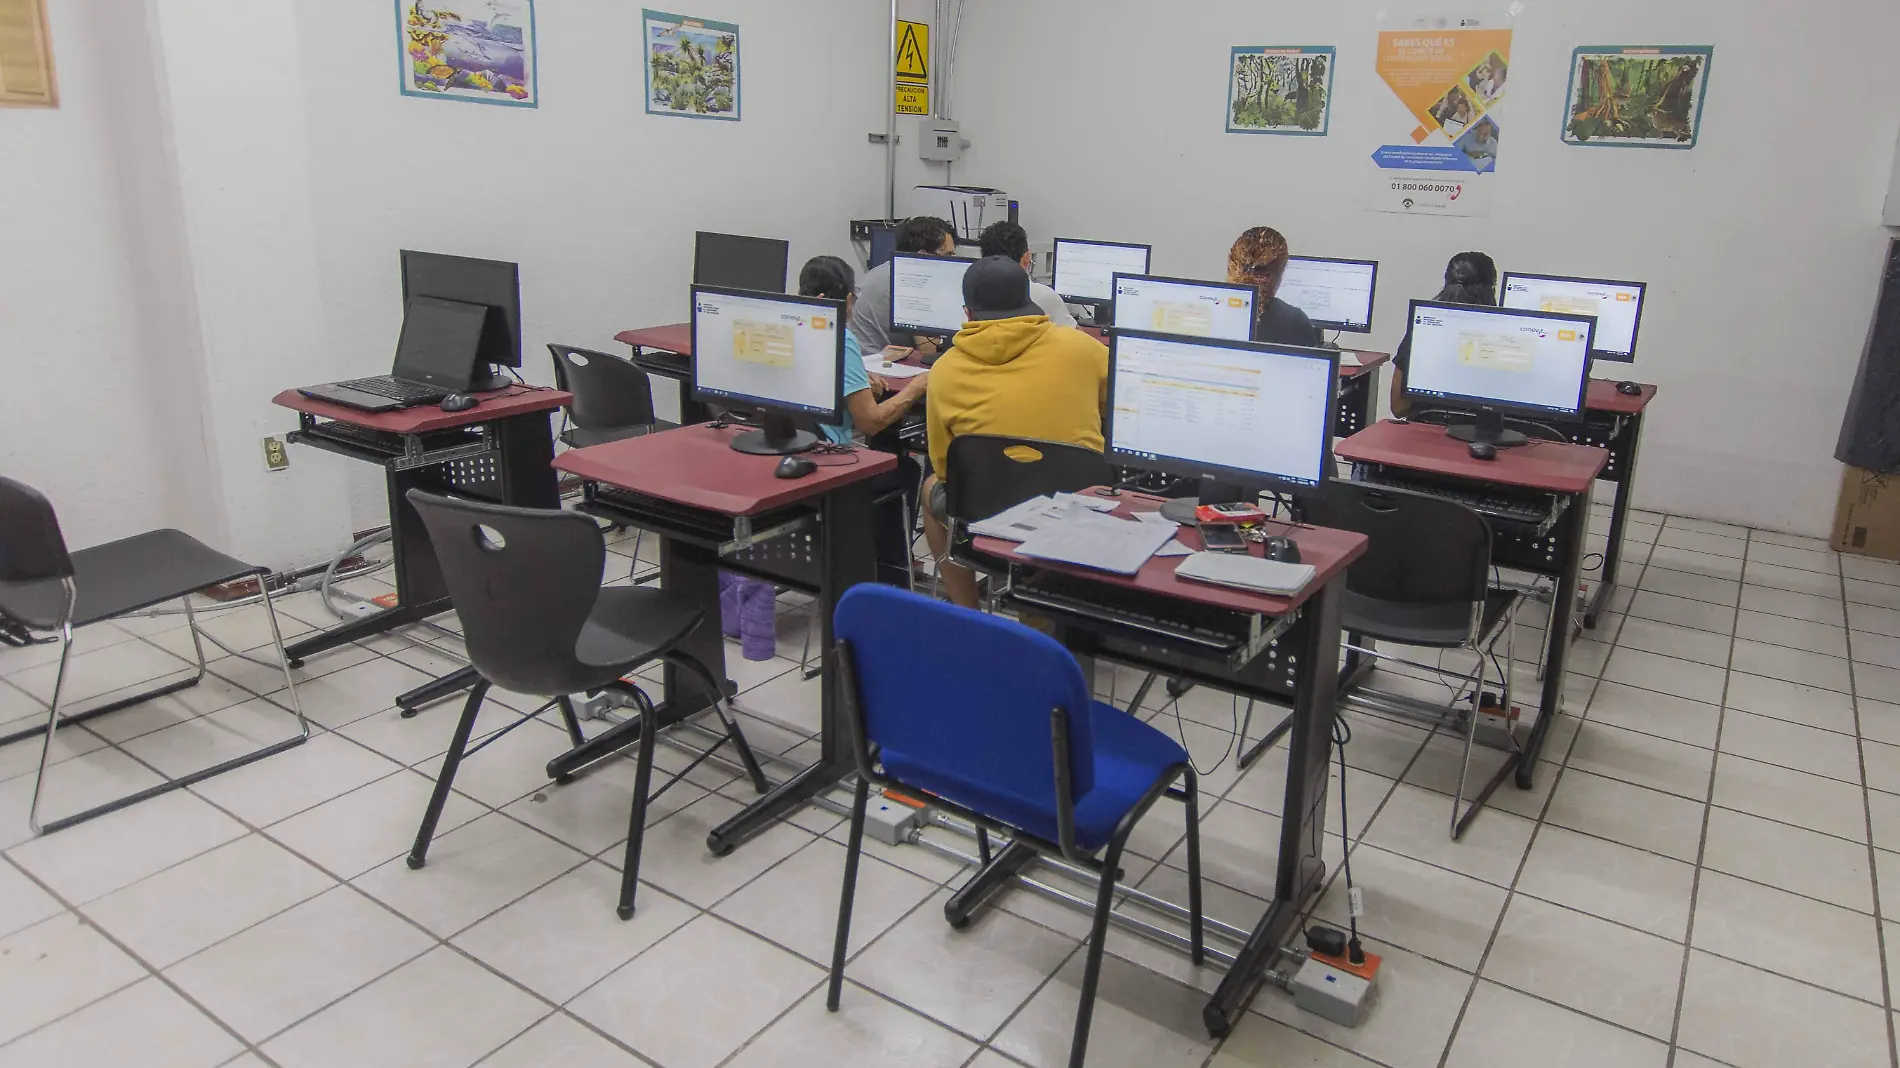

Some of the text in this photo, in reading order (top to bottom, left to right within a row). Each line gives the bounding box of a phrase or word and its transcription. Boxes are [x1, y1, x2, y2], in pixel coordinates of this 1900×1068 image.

[903, 95, 917, 103] ALTA
[897, 104, 922, 113] TENSION
[1391, 182, 1455, 193] 01 800 060 0070
